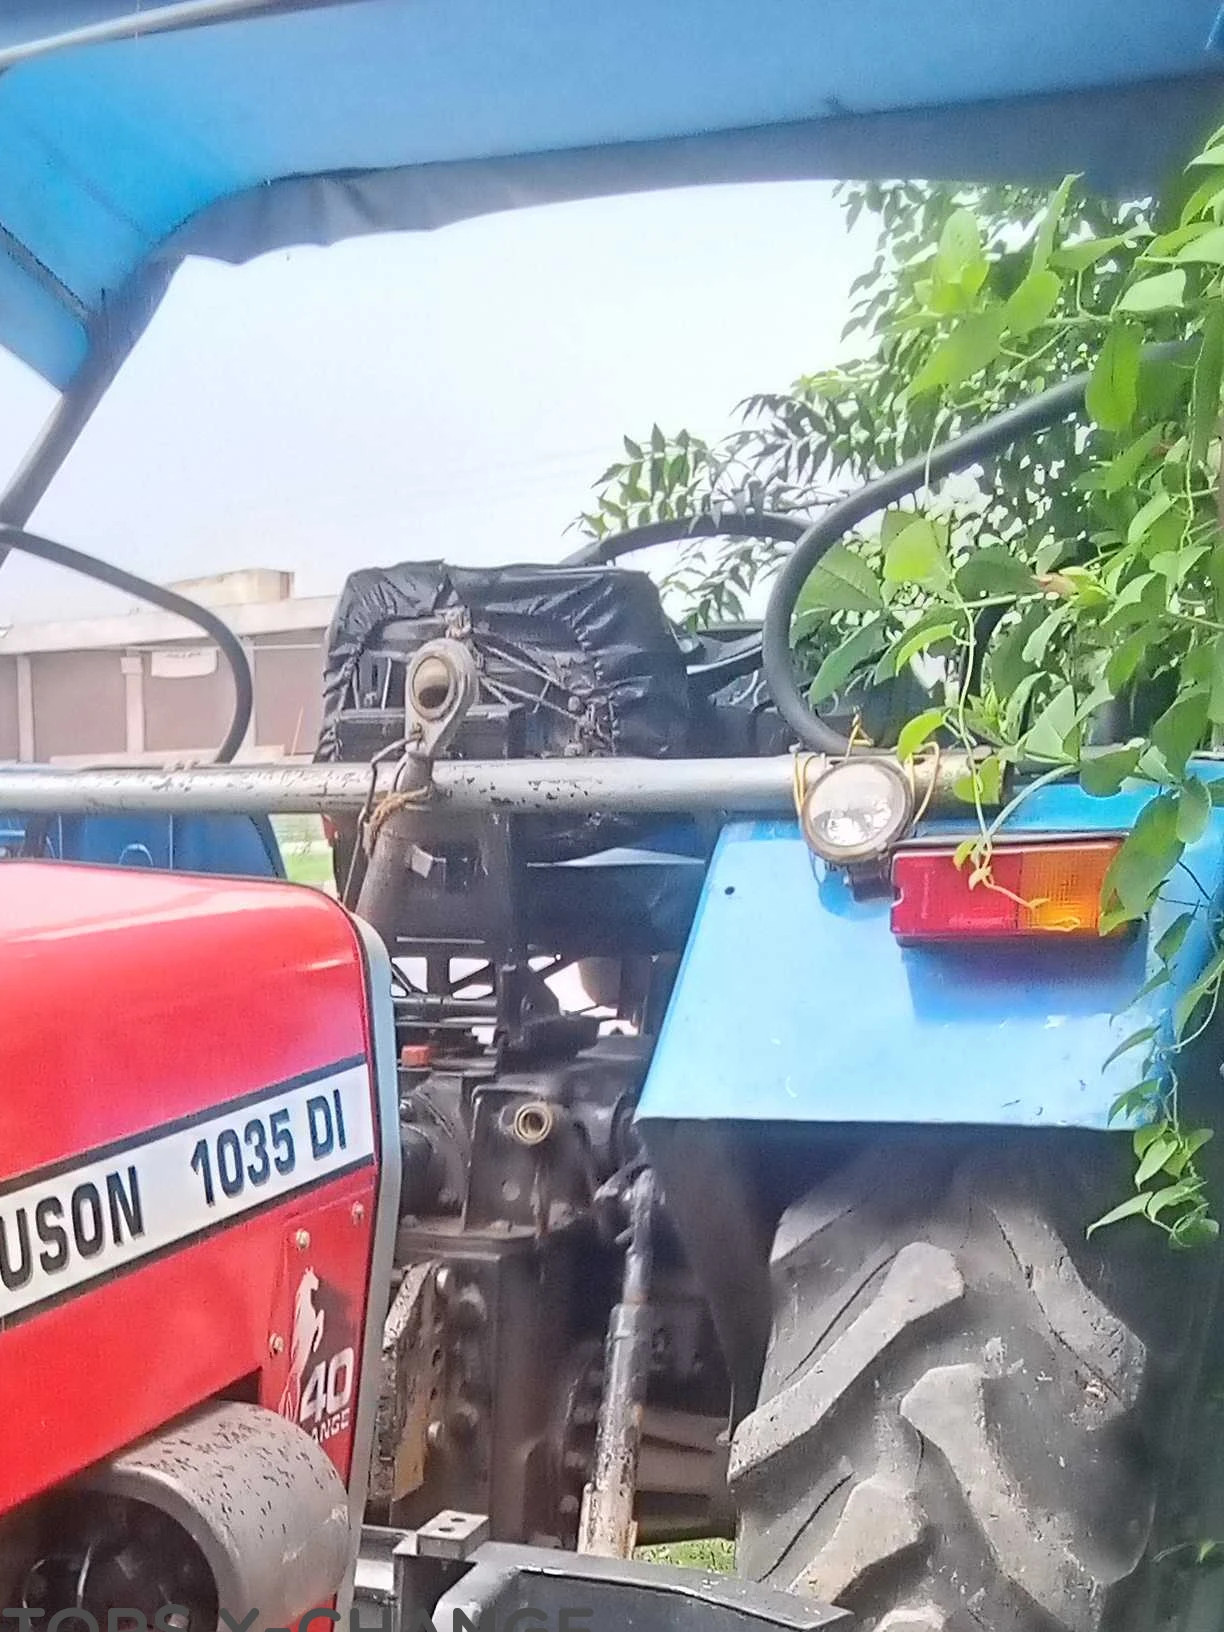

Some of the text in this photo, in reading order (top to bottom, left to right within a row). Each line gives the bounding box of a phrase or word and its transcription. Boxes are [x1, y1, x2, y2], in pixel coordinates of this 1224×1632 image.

[190, 1106, 296, 1207] 1035
[306, 1089, 347, 1162] DI
[299, 1347, 355, 1423] 40
[311, 1408, 351, 1445] ANGE
